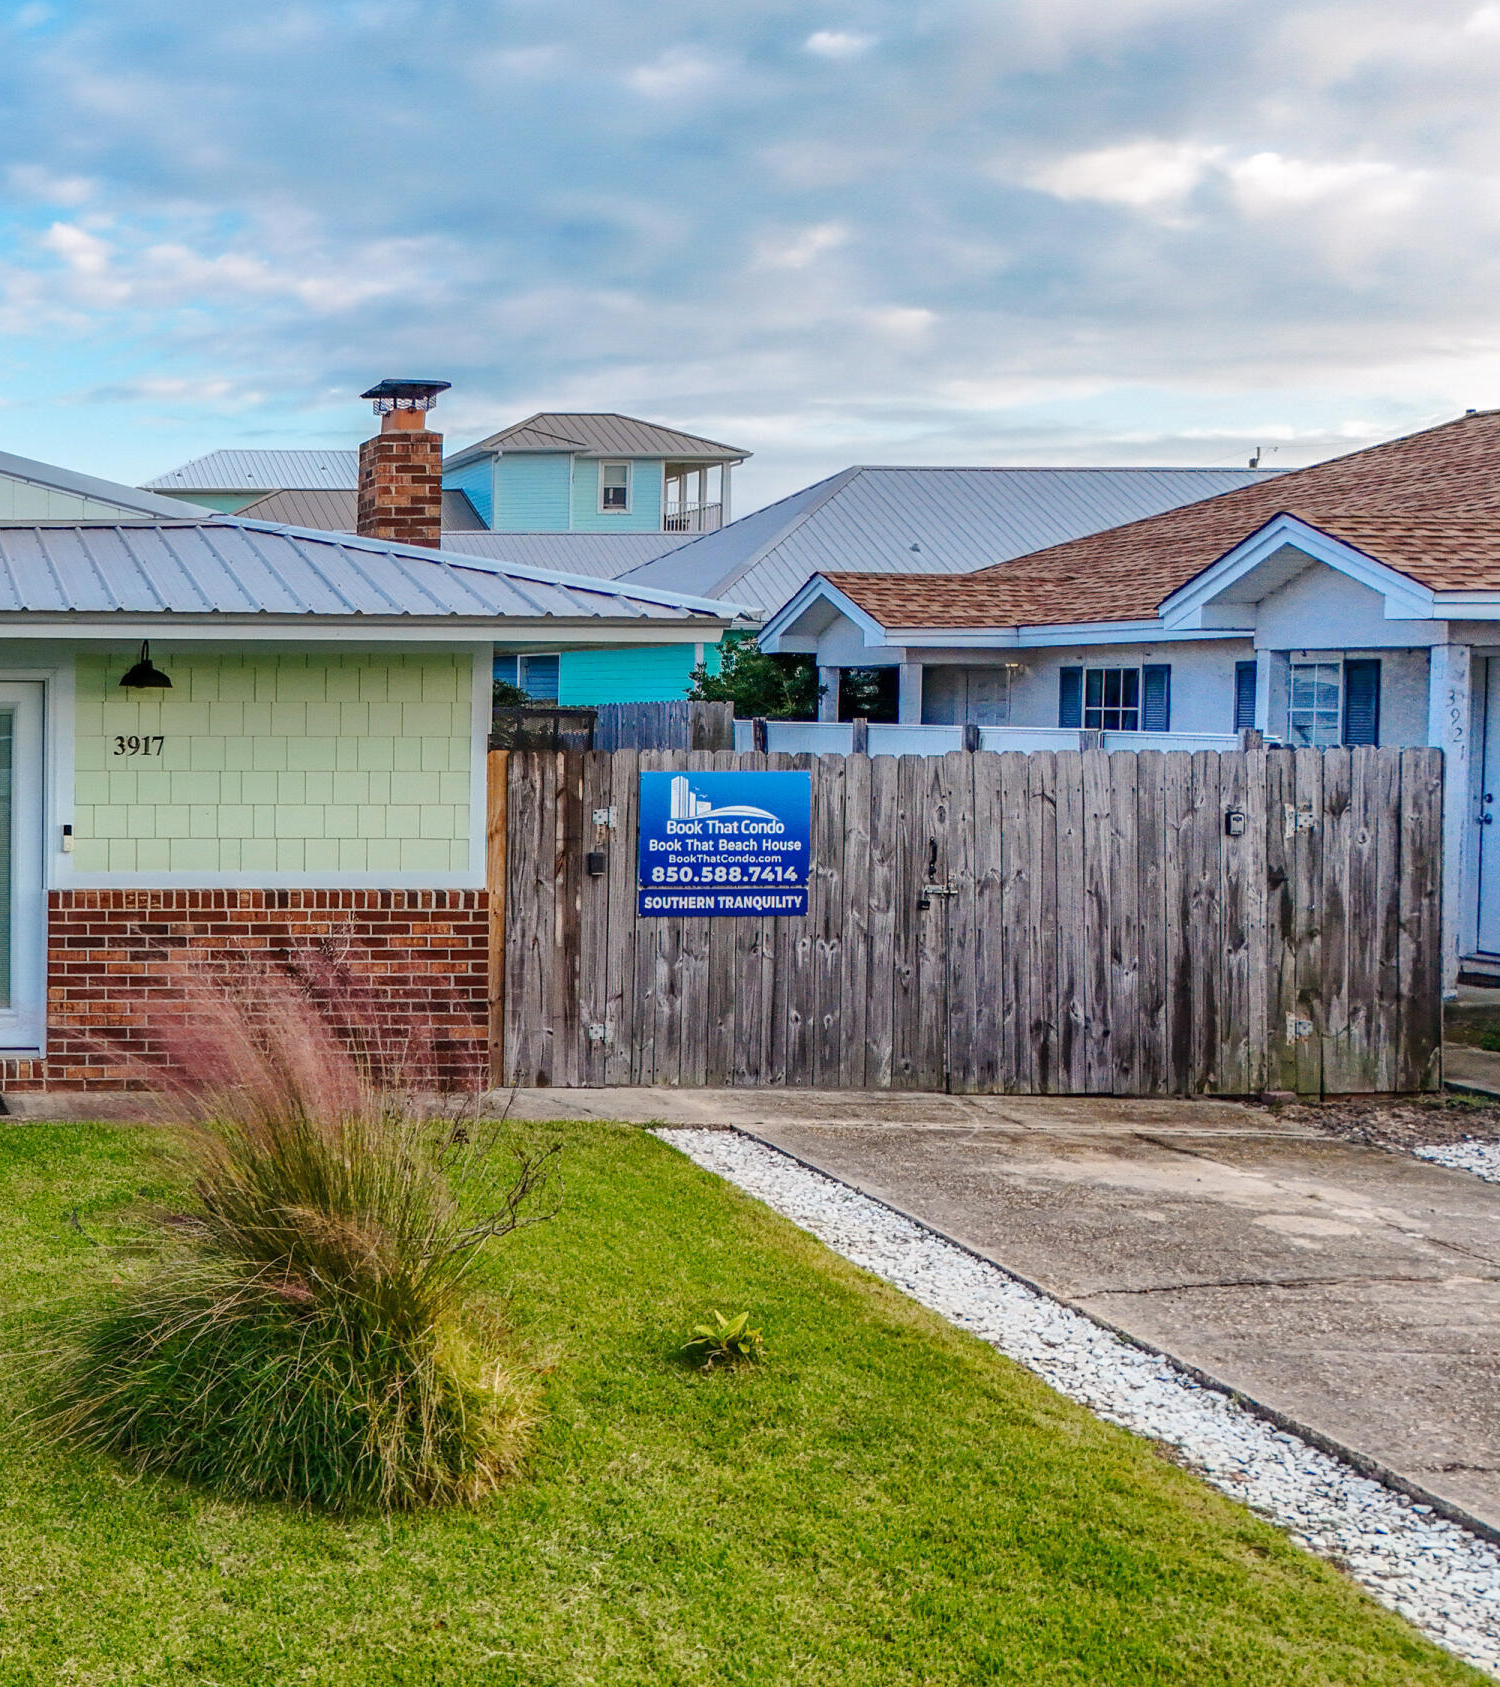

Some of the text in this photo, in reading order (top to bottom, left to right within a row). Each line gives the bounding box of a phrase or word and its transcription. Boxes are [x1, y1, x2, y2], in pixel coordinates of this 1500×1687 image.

[1445, 689, 1465, 760] 3921
[113, 735, 165, 756] 3917
[666, 820, 785, 834] Book That Condo
[649, 839, 802, 851] Book That Beach House
[669, 854, 782, 863] BookThatCondo.com
[651, 866, 798, 882] 850.588.7414
[644, 896, 803, 910] SOUTHERN TRANQUILITY
